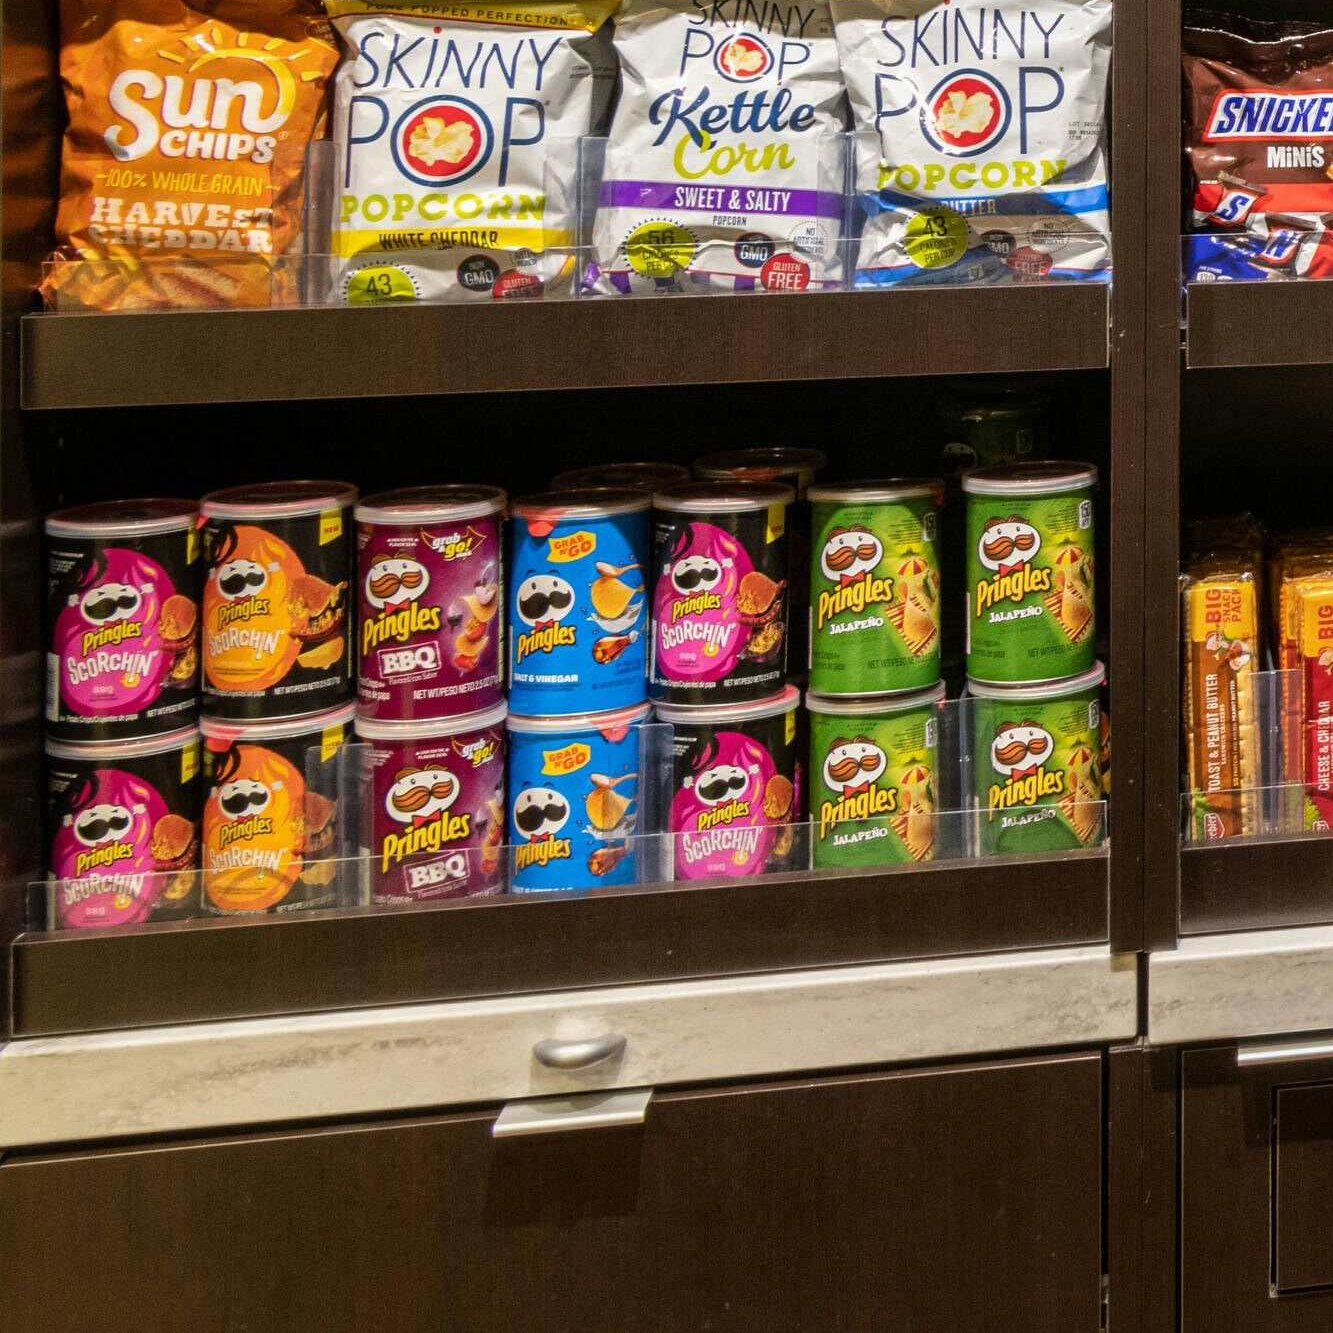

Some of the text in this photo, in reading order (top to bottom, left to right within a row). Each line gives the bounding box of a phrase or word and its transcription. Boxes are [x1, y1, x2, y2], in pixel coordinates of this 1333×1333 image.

[476, 9, 569, 27] PERFECTION
[878, 11, 1065, 68] SKINNY
[355, 27, 564, 91] SKINNY
[679, 28, 812, 87] POP
[104, 69, 285, 162] Sun
[649, 87, 817, 149] Kettle
[873, 66, 1065, 157] POP
[158, 129, 278, 163] CHIPS
[344, 95, 547, 189] POP
[673, 130, 796, 180] Corn
[151, 171, 264, 197] WHOLE GRAIN
[877, 159, 1067, 192] POPCORN
[90, 197, 275, 229] HARVEST
[341, 193, 547, 224] POPCORN
[674, 186, 791, 212] SWEET SALTY
[712, 215, 748, 226] POPCORN
[554, 536, 584, 550] GRAB
[672, 591, 721, 623] Pringles
[817, 574, 894, 622] Pringles
[363, 602, 441, 655] Pringles
[829, 615, 884, 635] JALAPEÑO
[1318, 605, 1333, 640] BIG
[382, 646, 437, 673] BBQ
[517, 623, 576, 664] Pringles
[536, 674, 578, 682] VINEGAR
[1206, 674, 1221, 791] TOAST PEANUT BUTTER
[1317, 755, 1330, 791] CHEESE
[408, 856, 467, 889] BBQ
